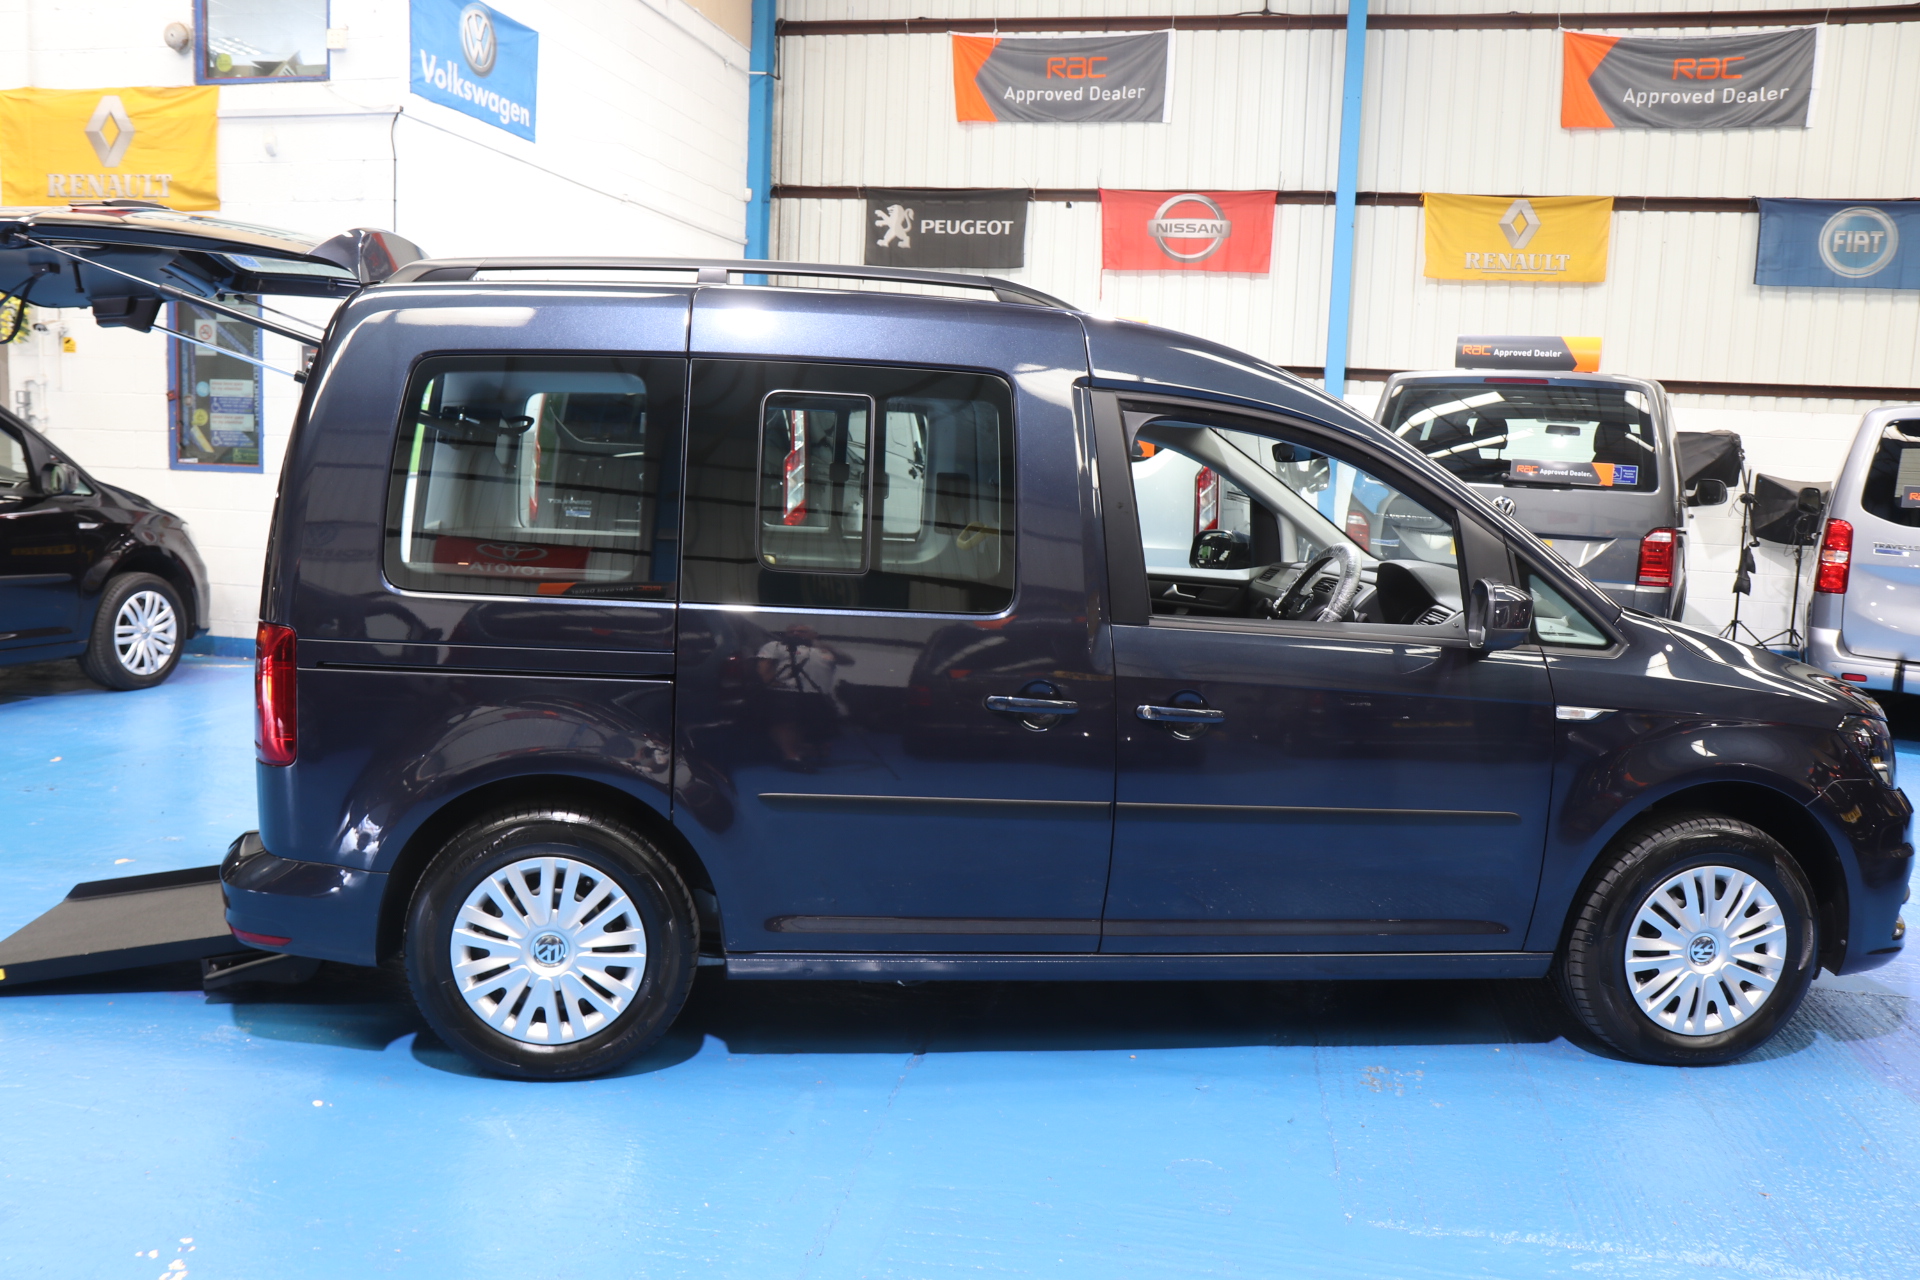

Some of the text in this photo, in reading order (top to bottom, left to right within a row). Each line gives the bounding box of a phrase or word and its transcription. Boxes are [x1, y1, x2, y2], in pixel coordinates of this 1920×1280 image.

[420, 48, 531, 127] Volkswagen
[1003, 86, 1146, 105] Approved Dealer
[1622, 87, 1790, 108] Approved Dealer
[46, 173, 173, 198] RENAULT
[920, 219, 1015, 235] PEUGEOT
[1155, 222, 1224, 234] NISSAN
[1832, 230, 1885, 253] FIAT
[1464, 252, 1571, 271] RENAULT
[1493, 348, 1532, 358] Approved
[1534, 349, 1562, 358] Dealer
[1539, 468, 1569, 476] Approved
